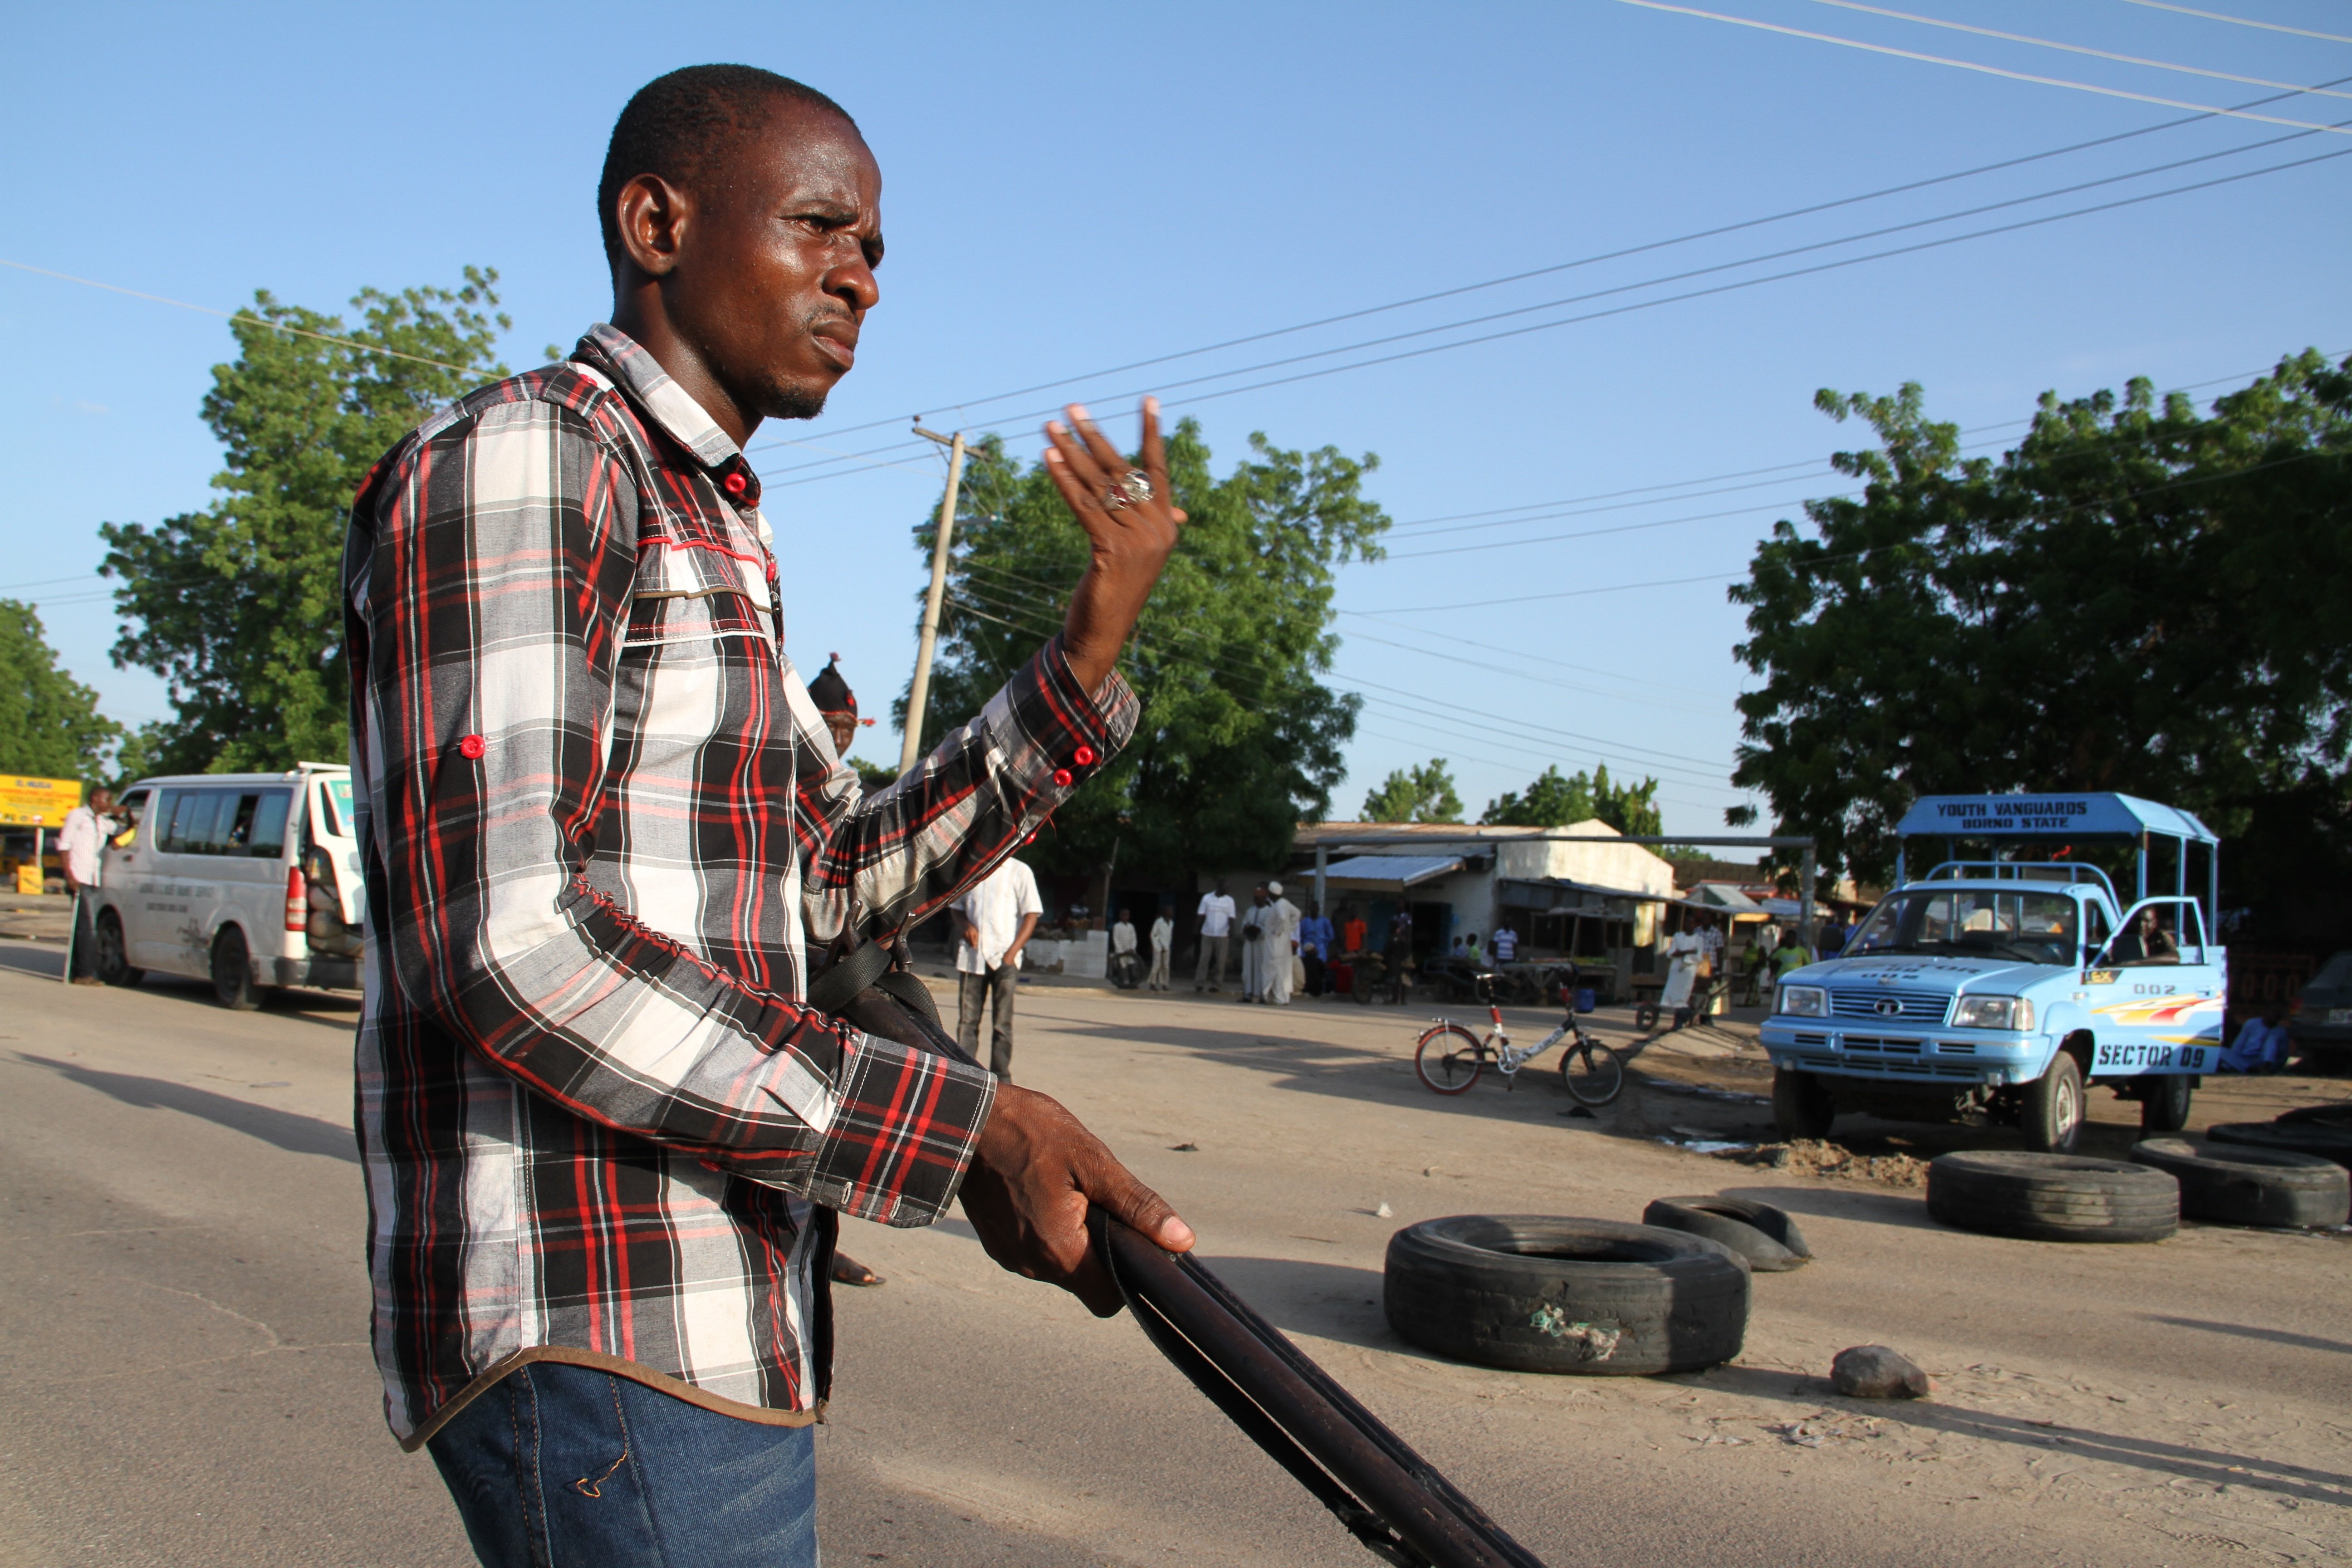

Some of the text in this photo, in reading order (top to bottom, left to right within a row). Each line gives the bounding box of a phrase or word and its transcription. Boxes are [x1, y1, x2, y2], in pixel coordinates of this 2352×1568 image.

[1937, 802, 2087, 816] YOUTH VANGUARDS
[1962, 817, 2069, 829] BORNO STATE
[2133, 984, 2176, 995] 002
[2098, 1045, 2205, 1068] SECTOR 09
